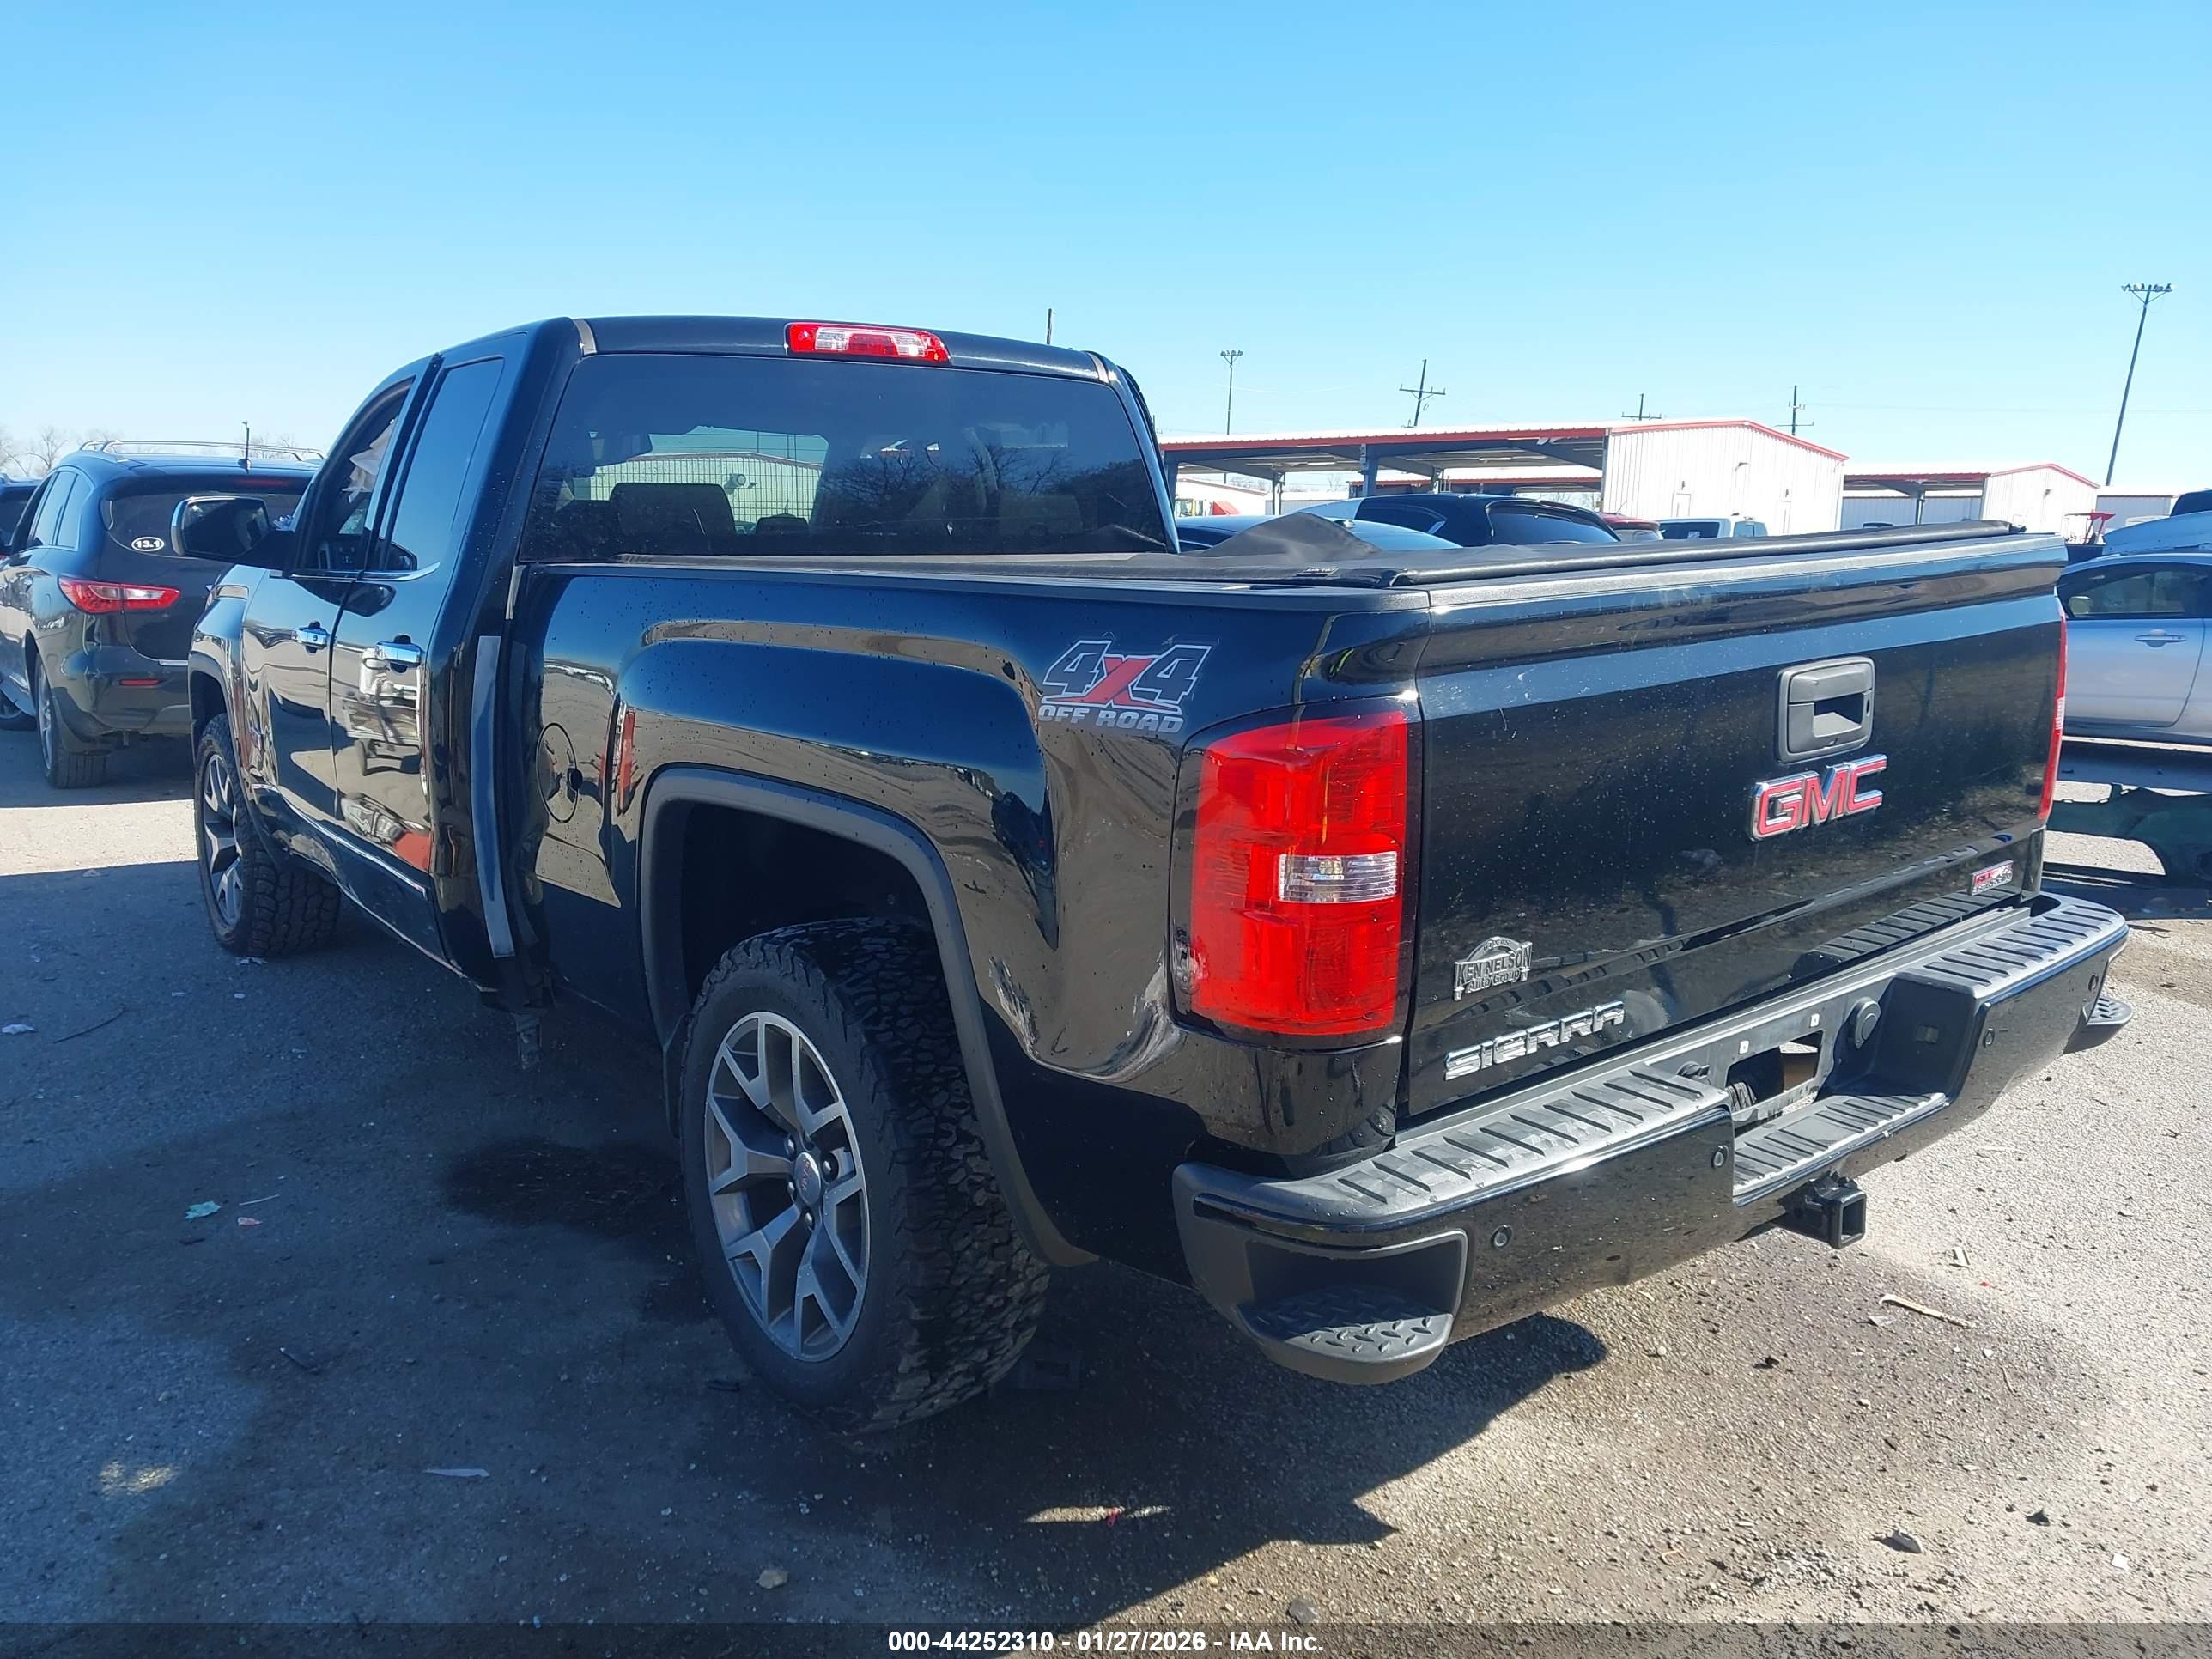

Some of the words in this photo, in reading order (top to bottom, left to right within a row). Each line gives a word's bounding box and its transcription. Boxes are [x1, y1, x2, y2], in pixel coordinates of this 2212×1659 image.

[1037, 704, 1091, 724] OFF
[1095, 710, 1184, 734] ROAD
[1748, 754, 1887, 842] GMC
[1460, 962, 1482, 988] KEN
[1486, 945, 1531, 975] NELSON
[1443, 1000, 1625, 1082] SIERRA
